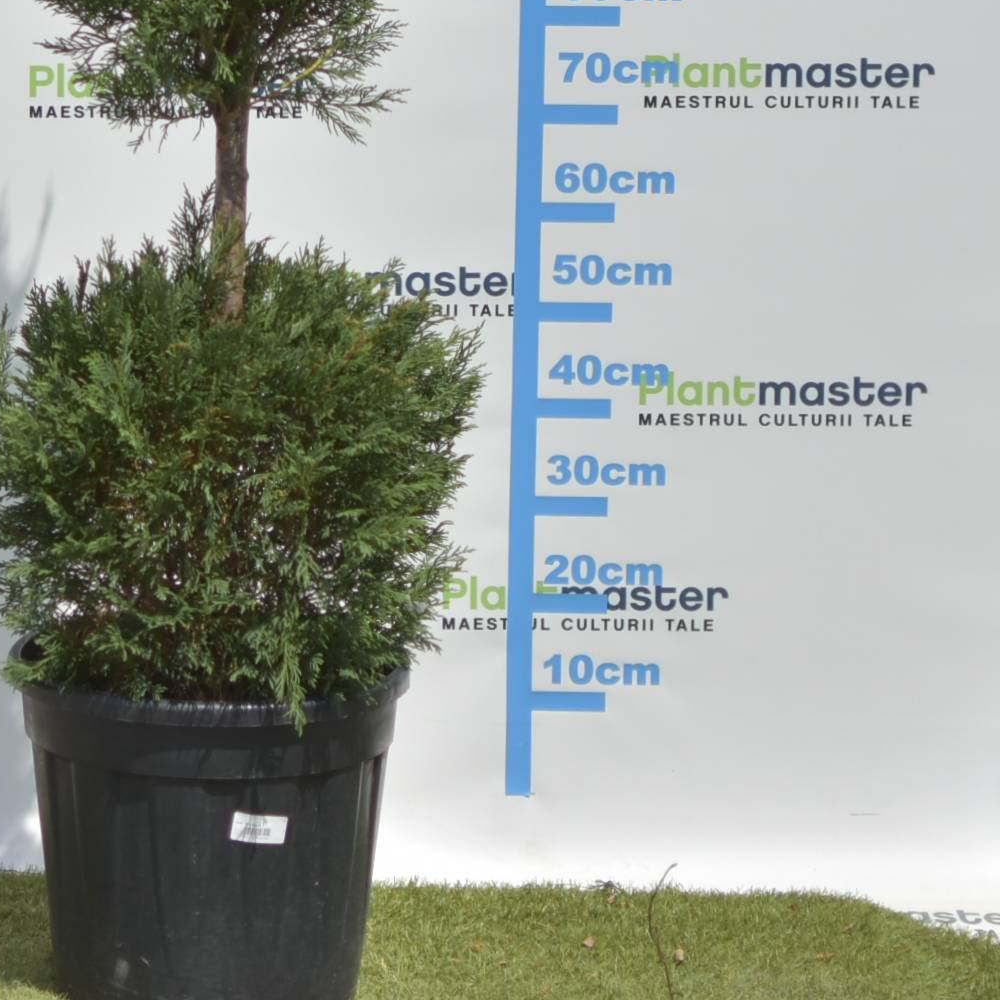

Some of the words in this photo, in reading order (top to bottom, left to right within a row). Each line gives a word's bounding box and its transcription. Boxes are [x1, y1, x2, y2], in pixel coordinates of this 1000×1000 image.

[558, 52, 679, 84] 70cm
[644, 96, 753, 108] MAESTRUL
[765, 96, 858, 108] CULTURII
[871, 96, 919, 108] TALE
[555, 163, 675, 194] 60cm
[553, 255, 672, 285] 50cm
[549, 355, 669, 386] 40cm
[639, 413, 747, 426] MAESTRUL
[759, 414, 851, 426] CULTURII
[864, 414, 912, 427] TALE
[548, 455, 666, 486] 30cm
[544, 554, 663, 586] 20cm
[561, 618, 654, 631] CULTURII
[665, 619, 713, 631] TALE
[544, 654, 660, 685] 10cm
